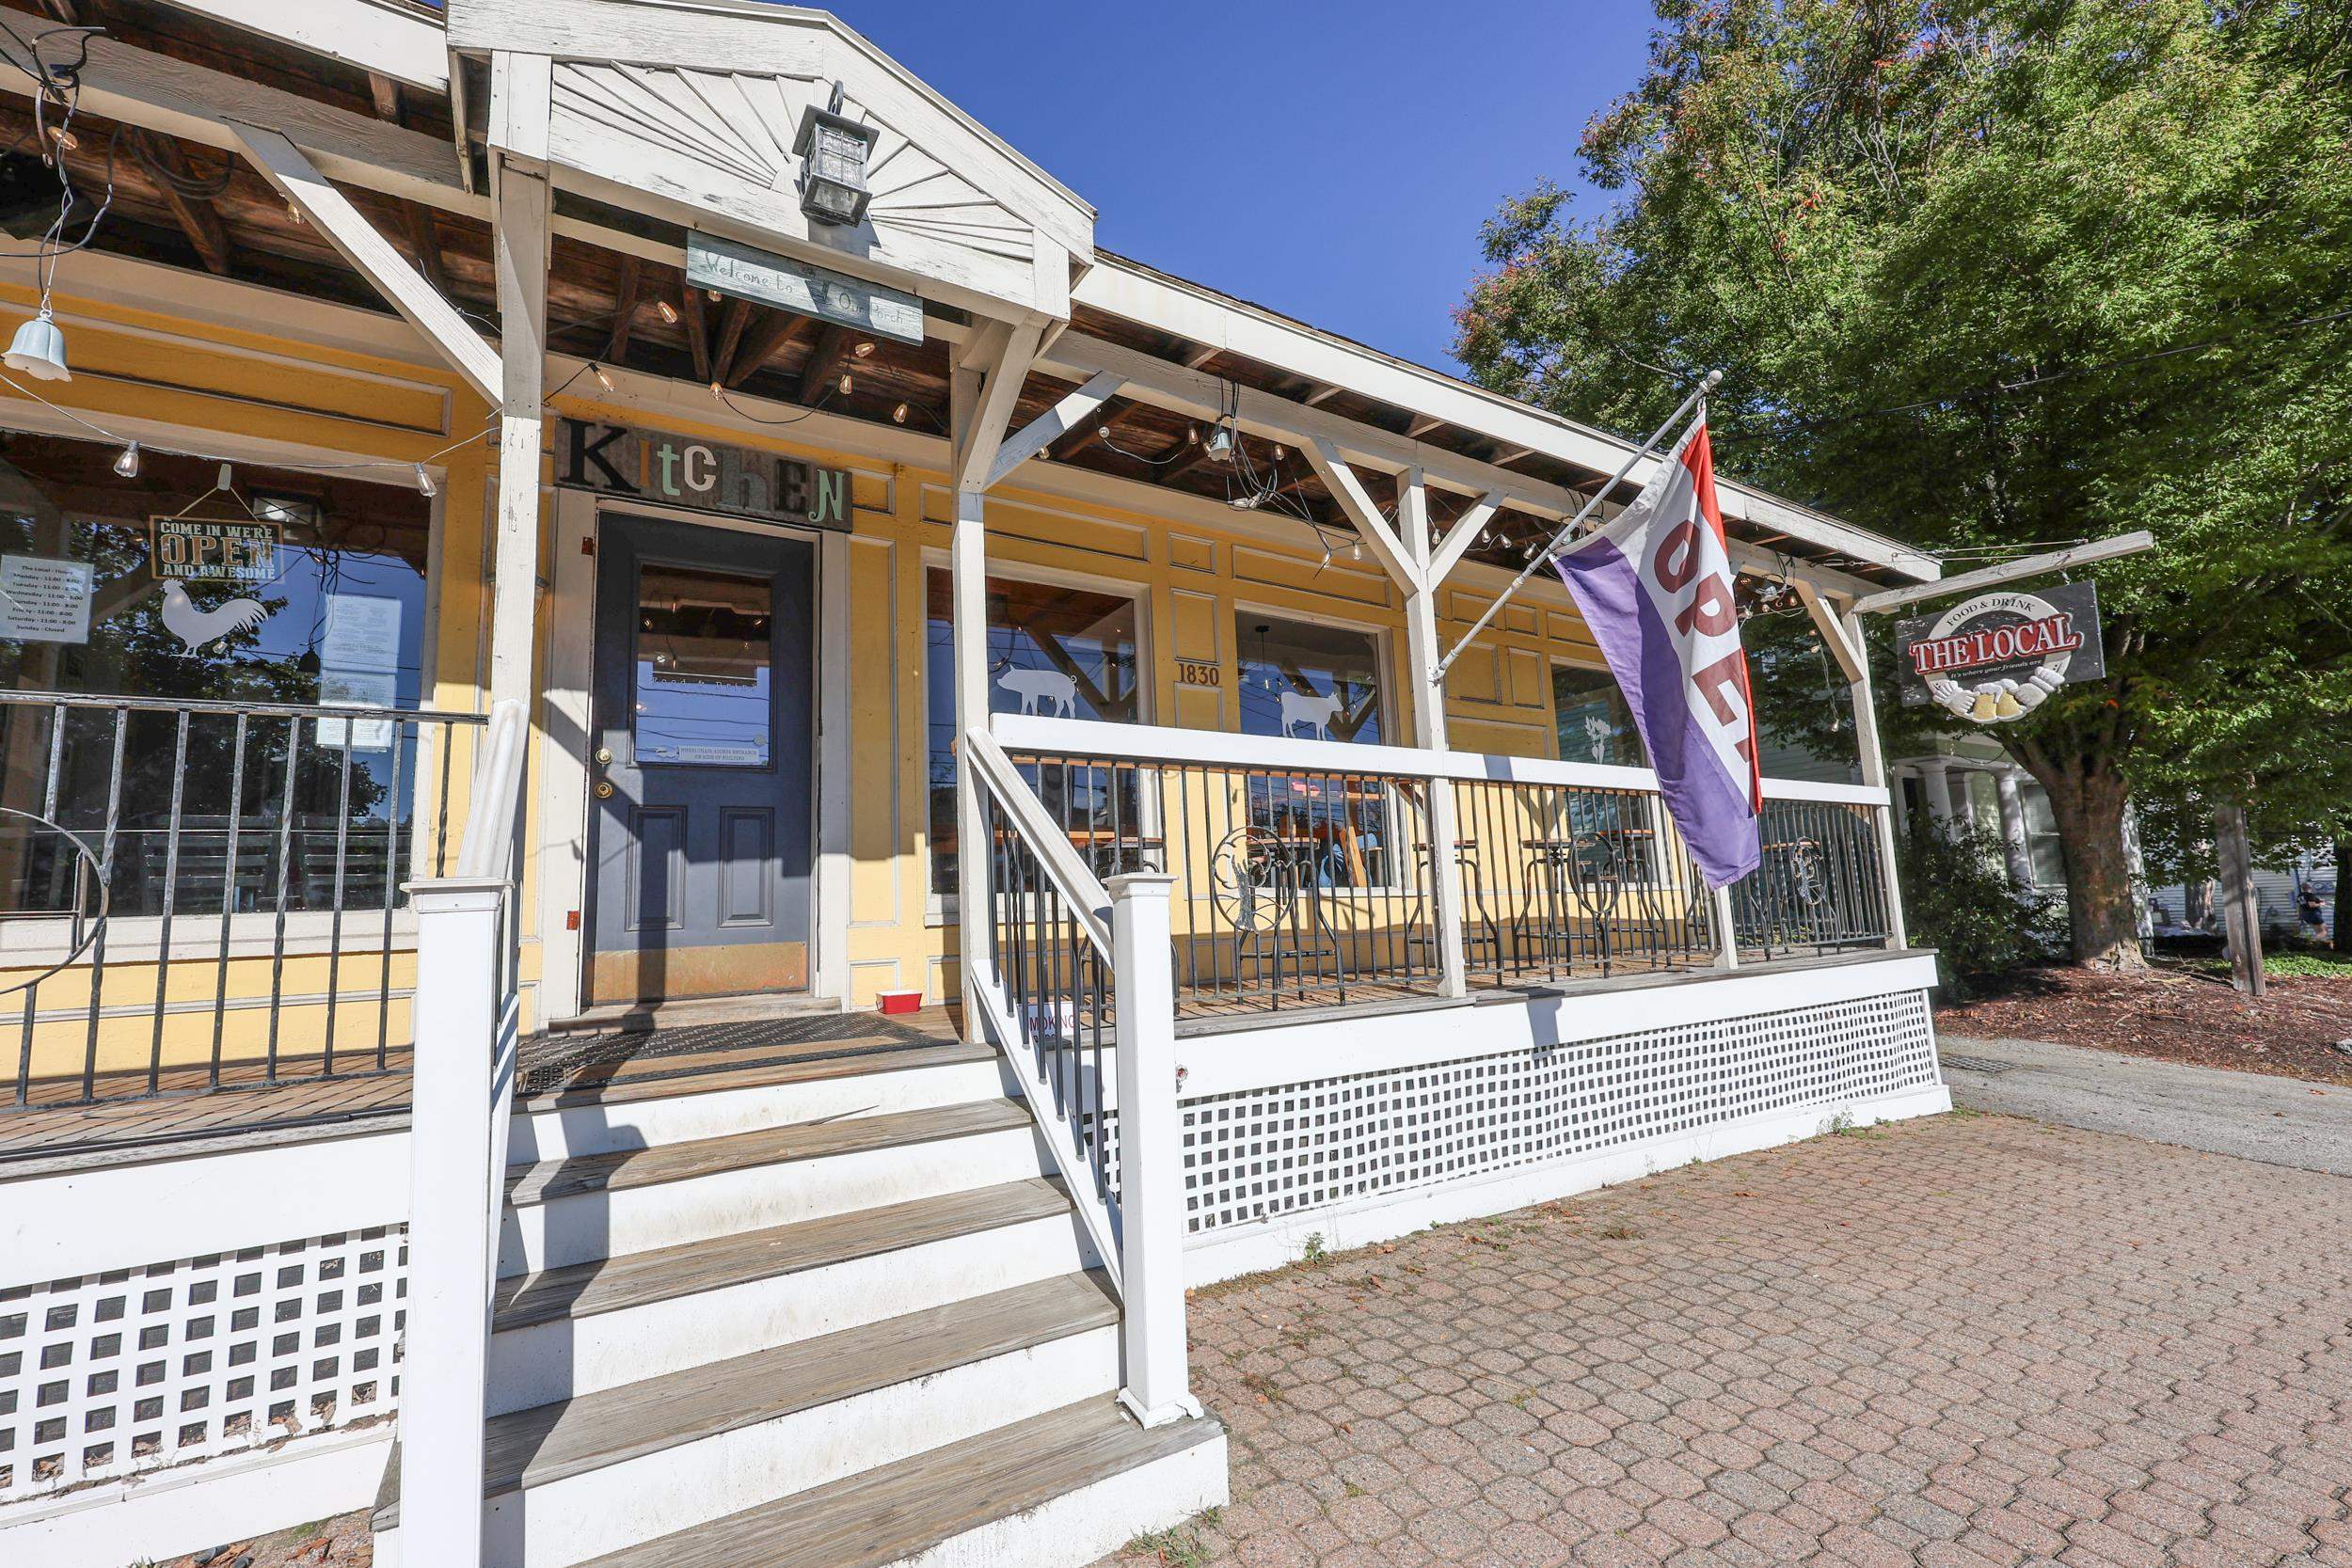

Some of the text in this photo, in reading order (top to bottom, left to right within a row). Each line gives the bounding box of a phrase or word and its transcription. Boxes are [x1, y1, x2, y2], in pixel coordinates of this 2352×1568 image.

[704, 251, 905, 325] Welcome to Our Porch
[160, 521, 273, 539] COME IN WE'RE
[160, 533, 275, 568] OPEN
[163, 563, 276, 579] AND AWESOME
[1947, 598, 2036, 627] FOOD & DRINK
[1654, 519, 1750, 764] OPE
[1913, 616, 2077, 672] THE LOCAL
[1178, 662, 1220, 686] 1830
[1963, 669, 1983, 677] where
[1984, 666, 2001, 674] your
[2001, 661, 2028, 672] friends
